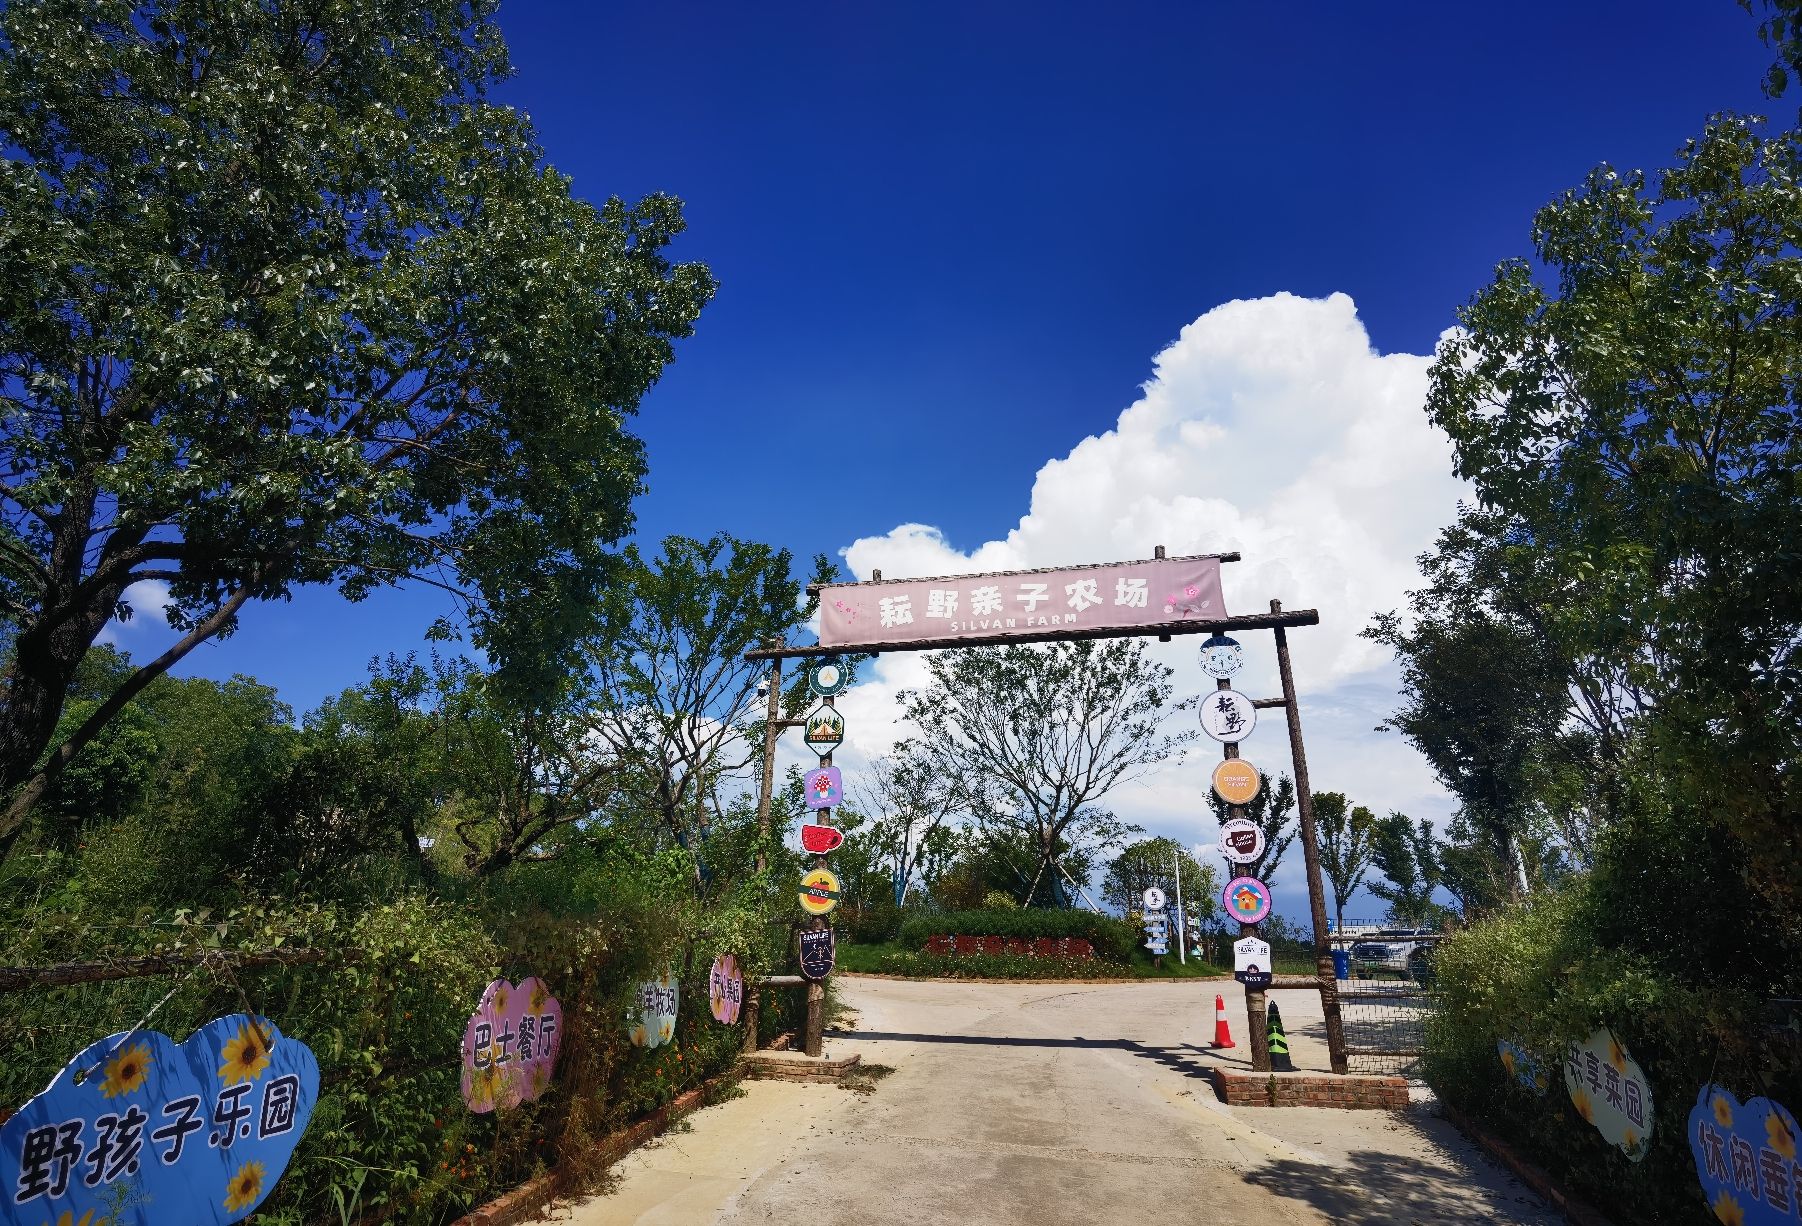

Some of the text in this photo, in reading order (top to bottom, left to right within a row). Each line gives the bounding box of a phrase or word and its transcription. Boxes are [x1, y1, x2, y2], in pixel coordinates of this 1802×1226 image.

[878, 577, 1149, 629] 耘野亲子农场
[950, 613, 1077, 632] SILVAN FARM
[808, 888, 829, 898] APPLE
[636, 983, 677, 1018] 羊牧场
[472, 1014, 556, 1069] 巴士餐厅
[1567, 1044, 1645, 1129] 共享菜园
[14, 1074, 301, 1205] 野孩子乐园
